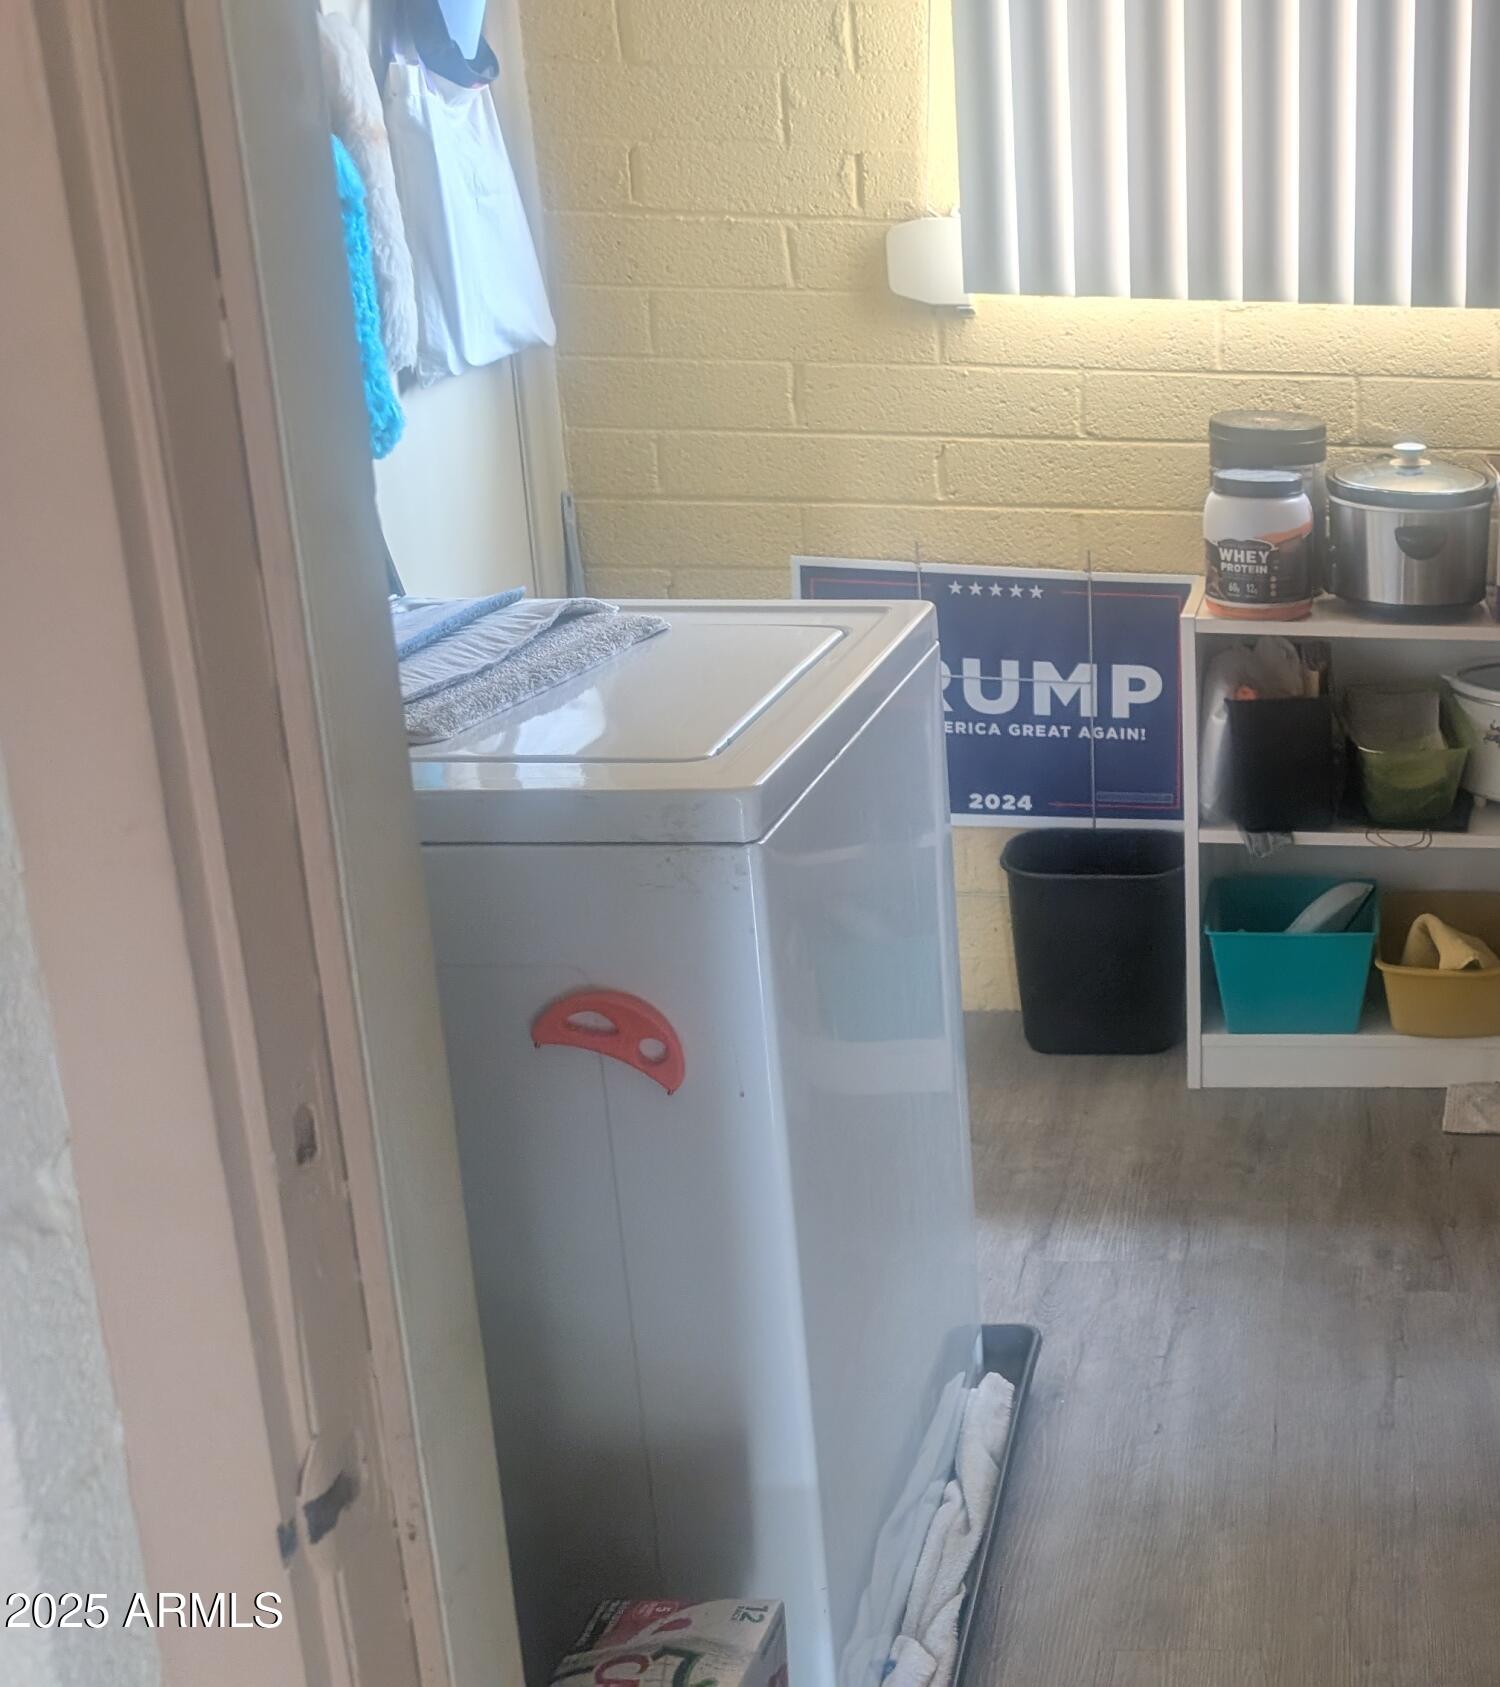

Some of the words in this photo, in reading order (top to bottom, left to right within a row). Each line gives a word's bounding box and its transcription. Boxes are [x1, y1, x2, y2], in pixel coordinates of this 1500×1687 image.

[1219, 547, 1270, 565] WHEY
[1220, 561, 1268, 575] PROTEIN
[940, 657, 1163, 719] UMP
[1008, 724, 1071, 738] GREAT
[1078, 726, 1146, 741] AGAIN!
[968, 793, 1033, 811] 2024
[738, 1605, 769, 1624] 12
